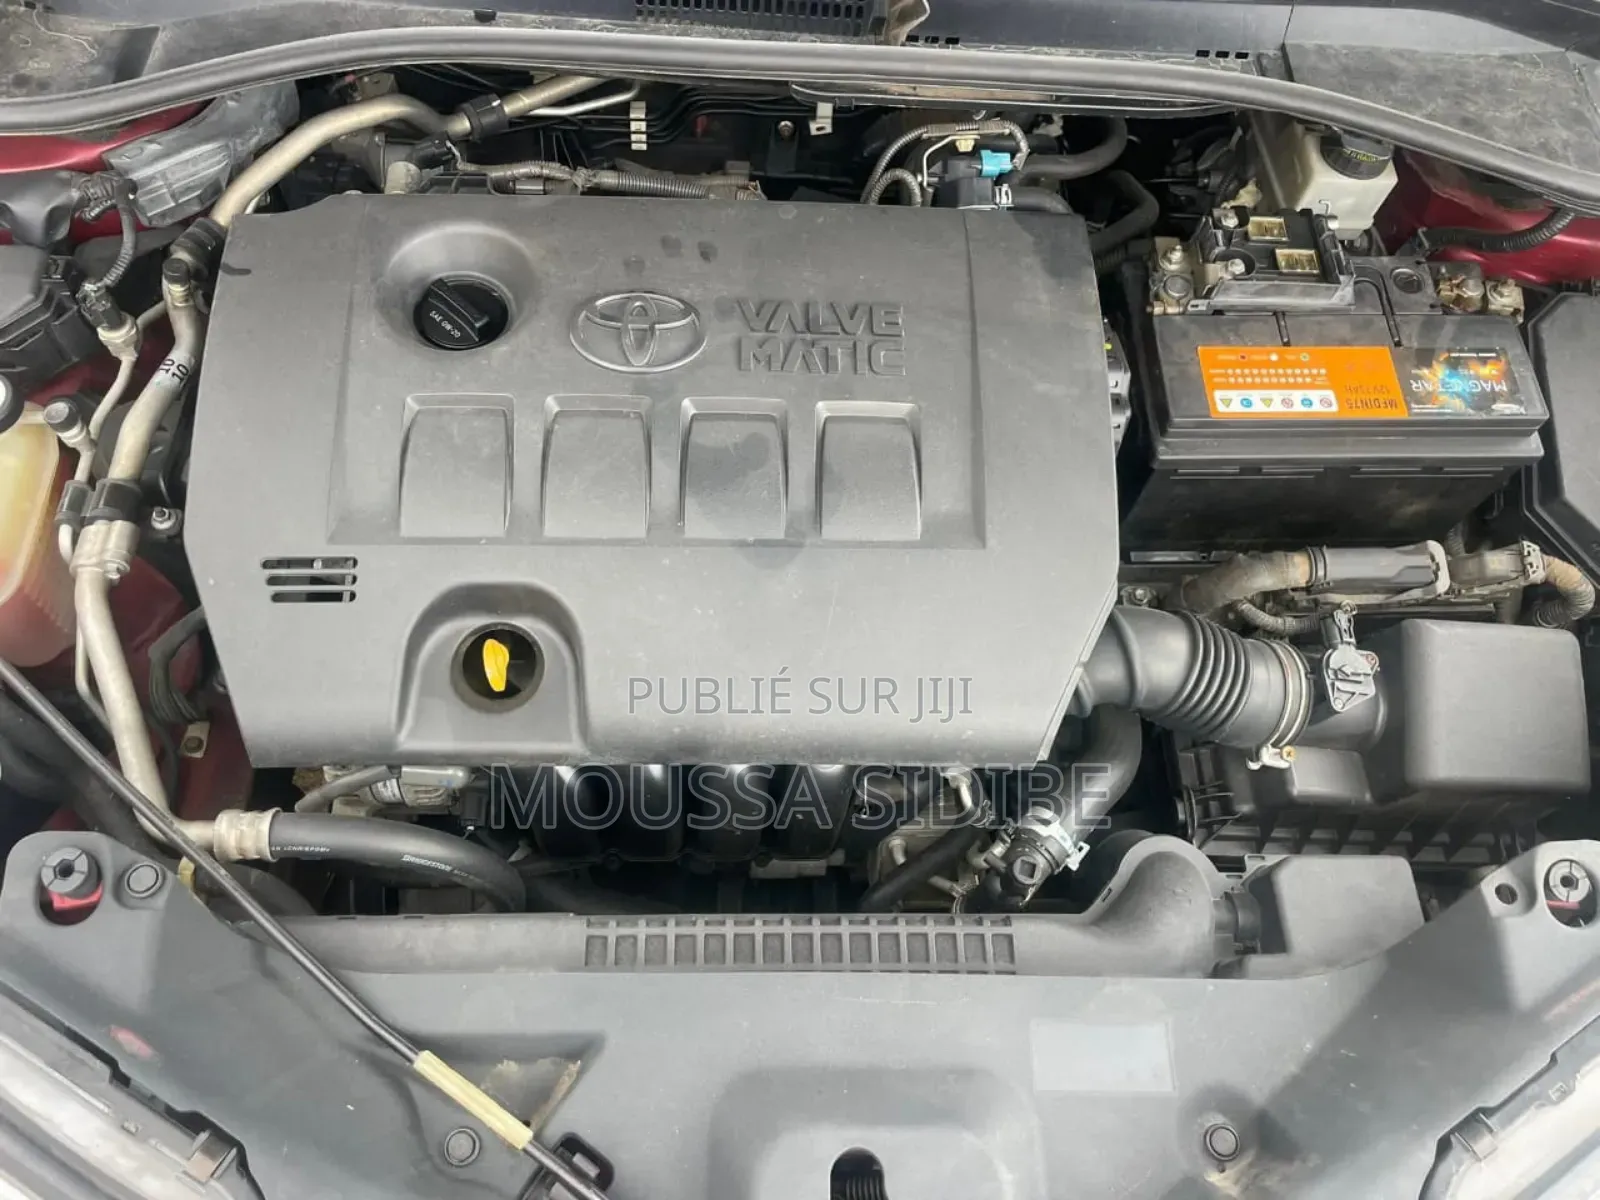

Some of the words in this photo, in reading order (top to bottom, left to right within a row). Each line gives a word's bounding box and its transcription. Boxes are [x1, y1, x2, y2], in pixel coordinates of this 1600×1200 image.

[429, 310, 443, 322] SAE
[736, 299, 905, 338] VALVE
[737, 335, 906, 376] MATIC
[171, 363, 190, 384] 10
